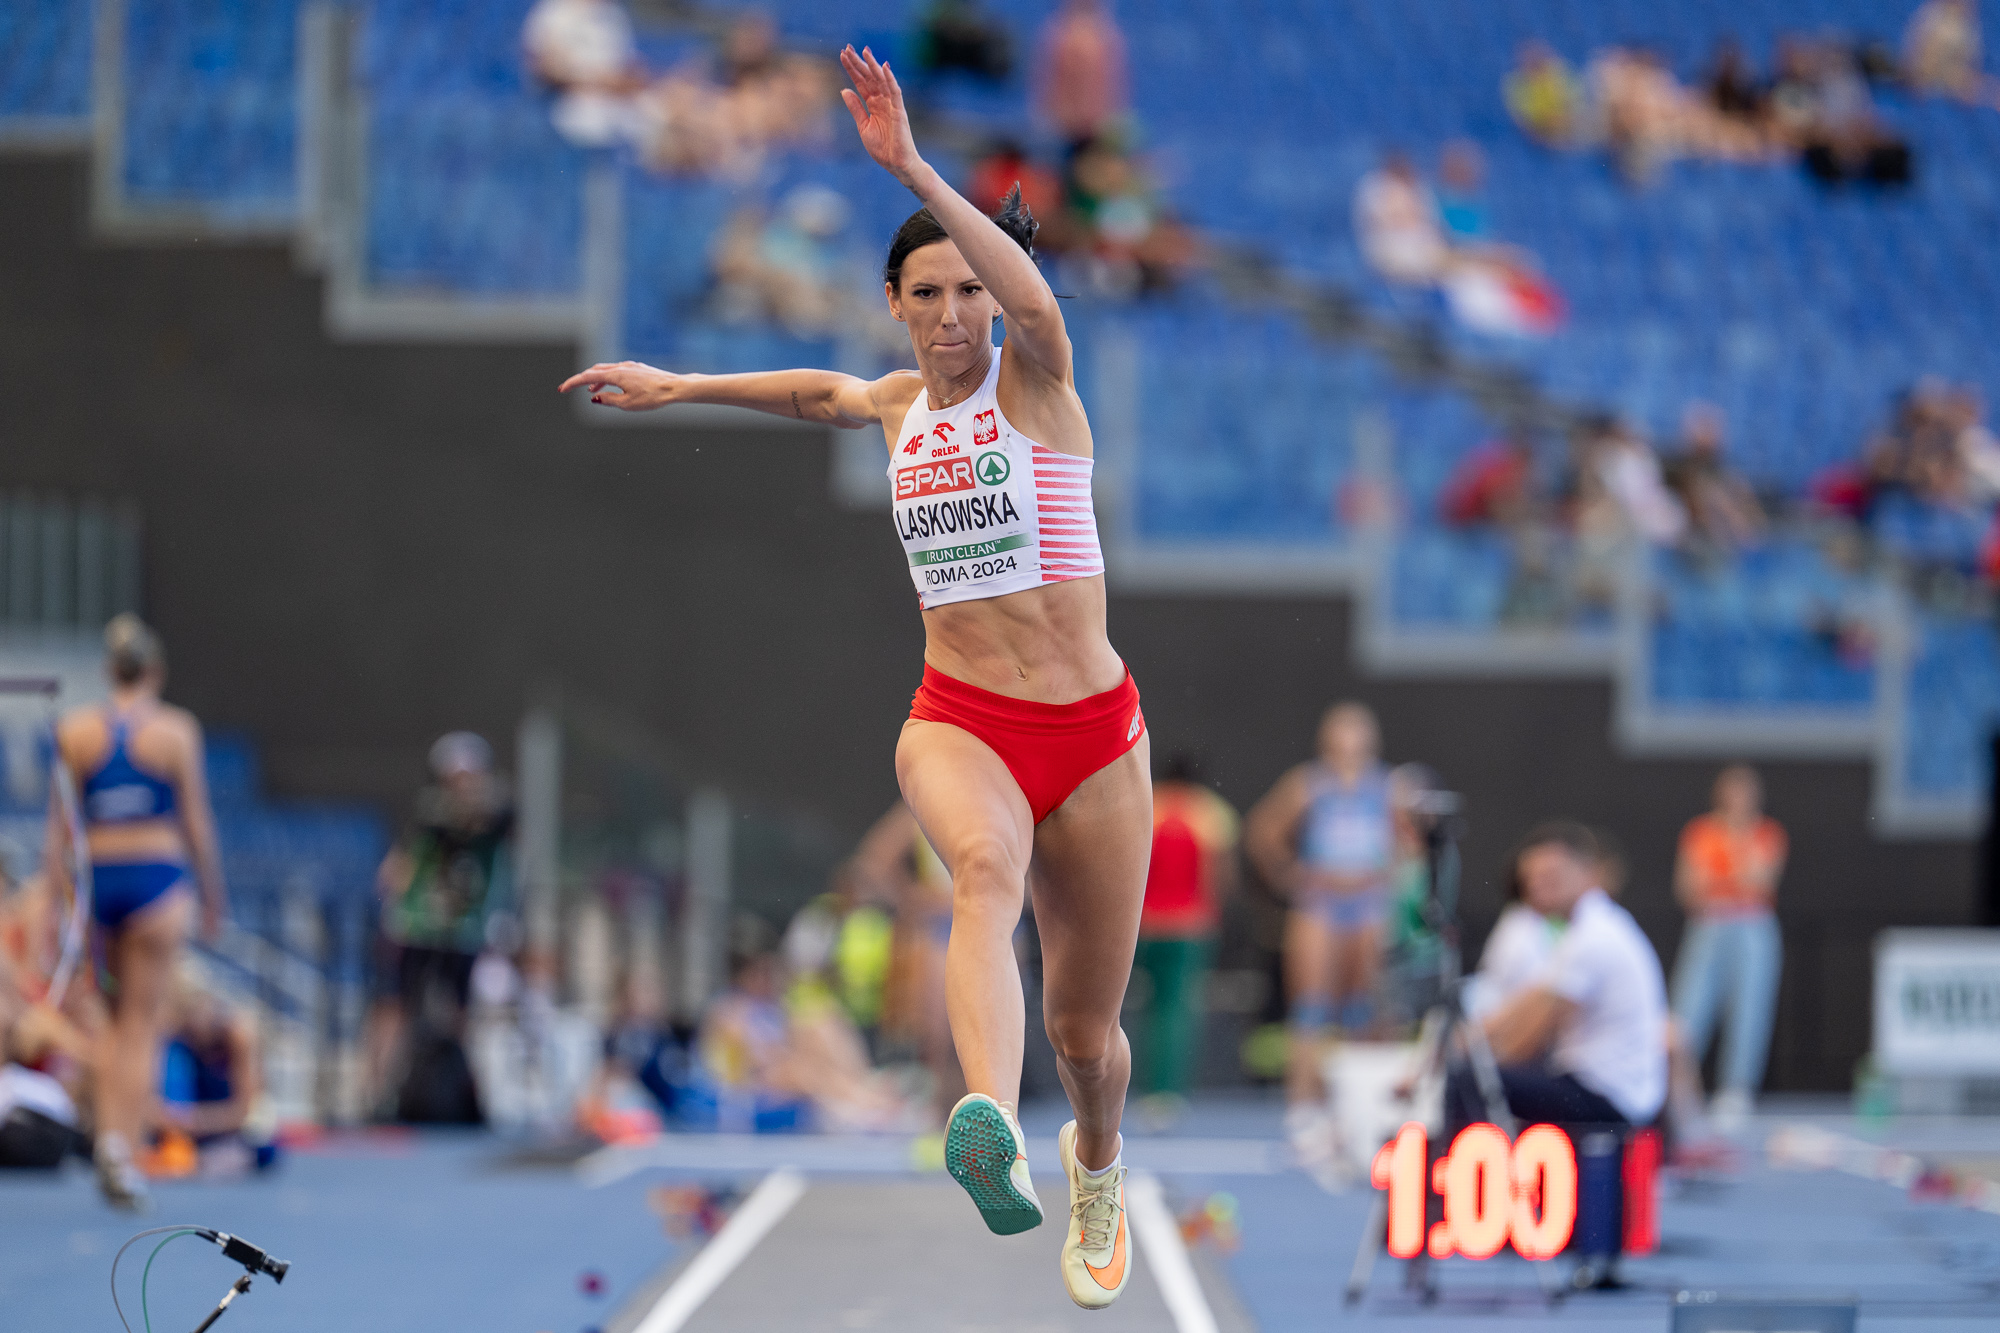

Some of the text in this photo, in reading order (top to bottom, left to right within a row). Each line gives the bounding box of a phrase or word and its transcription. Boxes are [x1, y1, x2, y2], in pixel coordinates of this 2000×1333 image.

[903, 433, 924, 455] 4F
[931, 444, 960, 458] ORLEN
[898, 461, 973, 496] SPAR
[896, 491, 1020, 541] LASKOWSKA
[925, 555, 1017, 586] ROMA 2024
